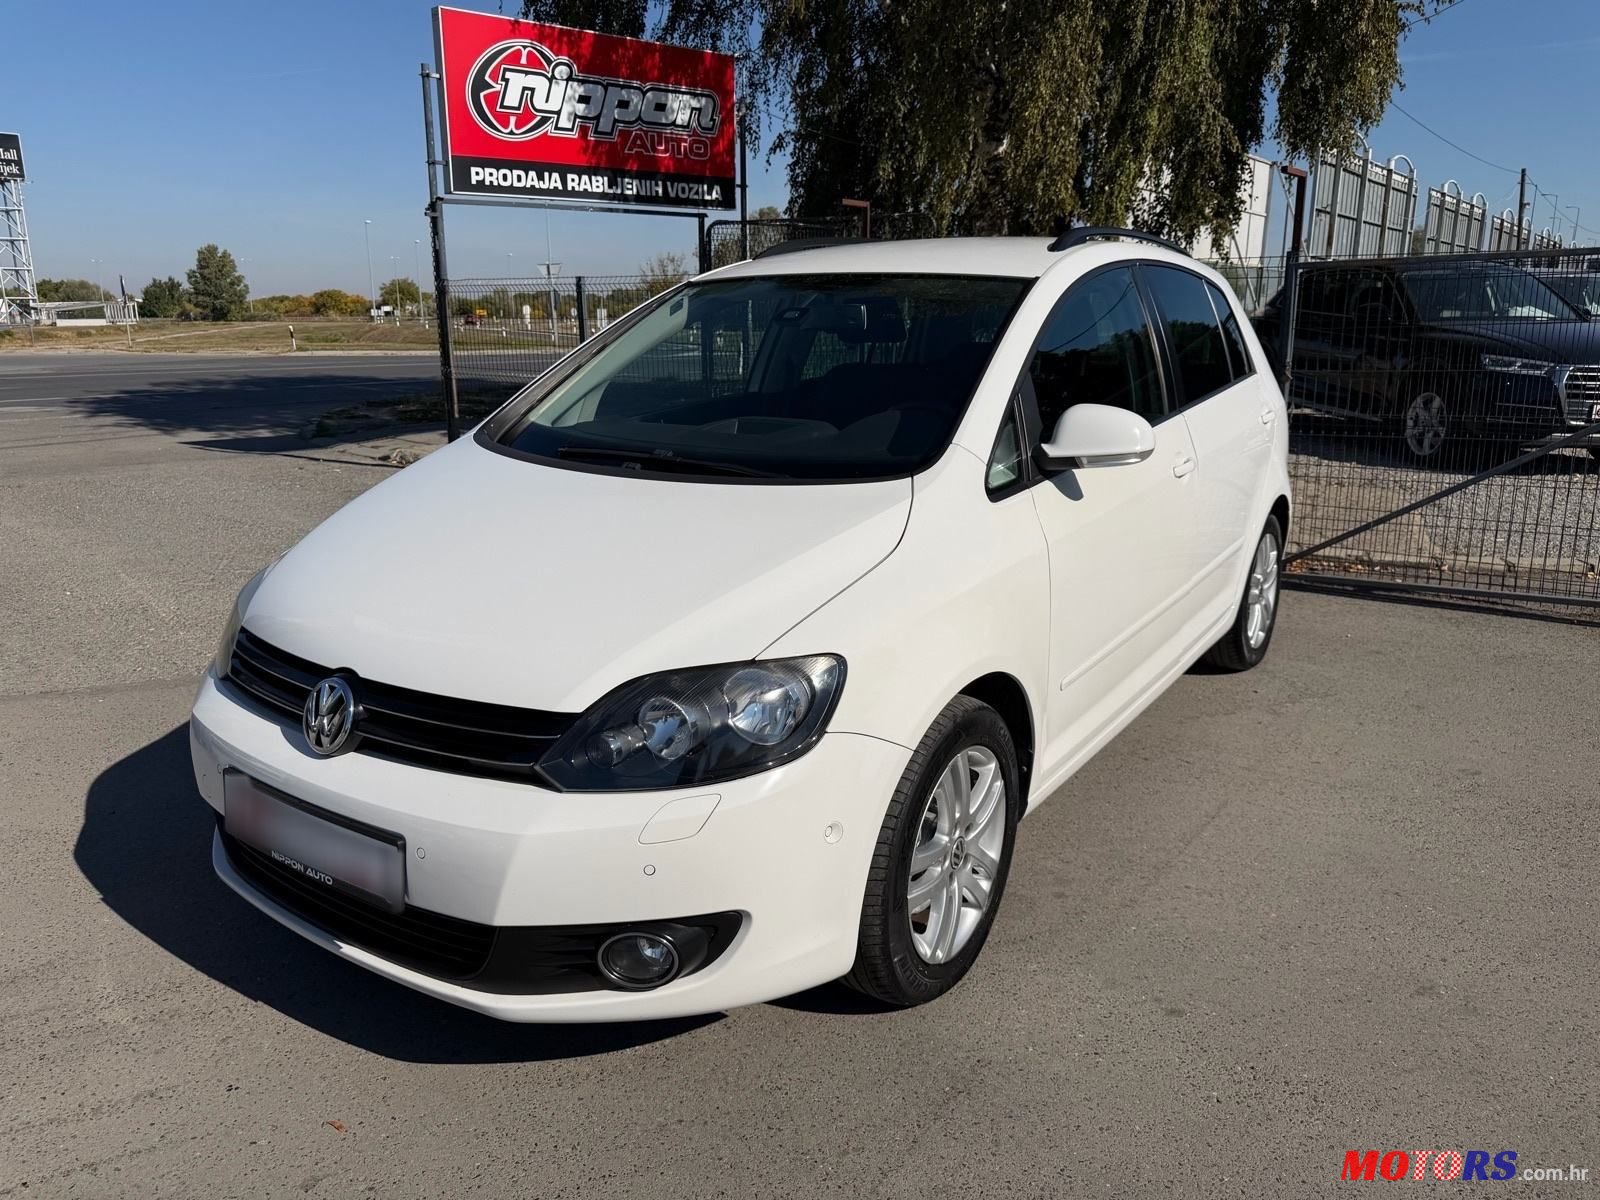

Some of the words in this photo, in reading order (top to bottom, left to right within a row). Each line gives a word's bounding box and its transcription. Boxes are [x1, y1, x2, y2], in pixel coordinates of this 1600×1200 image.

[501, 61, 716, 134] nippon
[624, 131, 711, 160] AUTO
[470, 166, 563, 191] PRODAJA
[566, 173, 663, 197] RABLJENIH
[666, 181, 722, 201] VOZILA
[271, 850, 304, 873] NIPPON
[306, 867, 333, 885] AUTO
